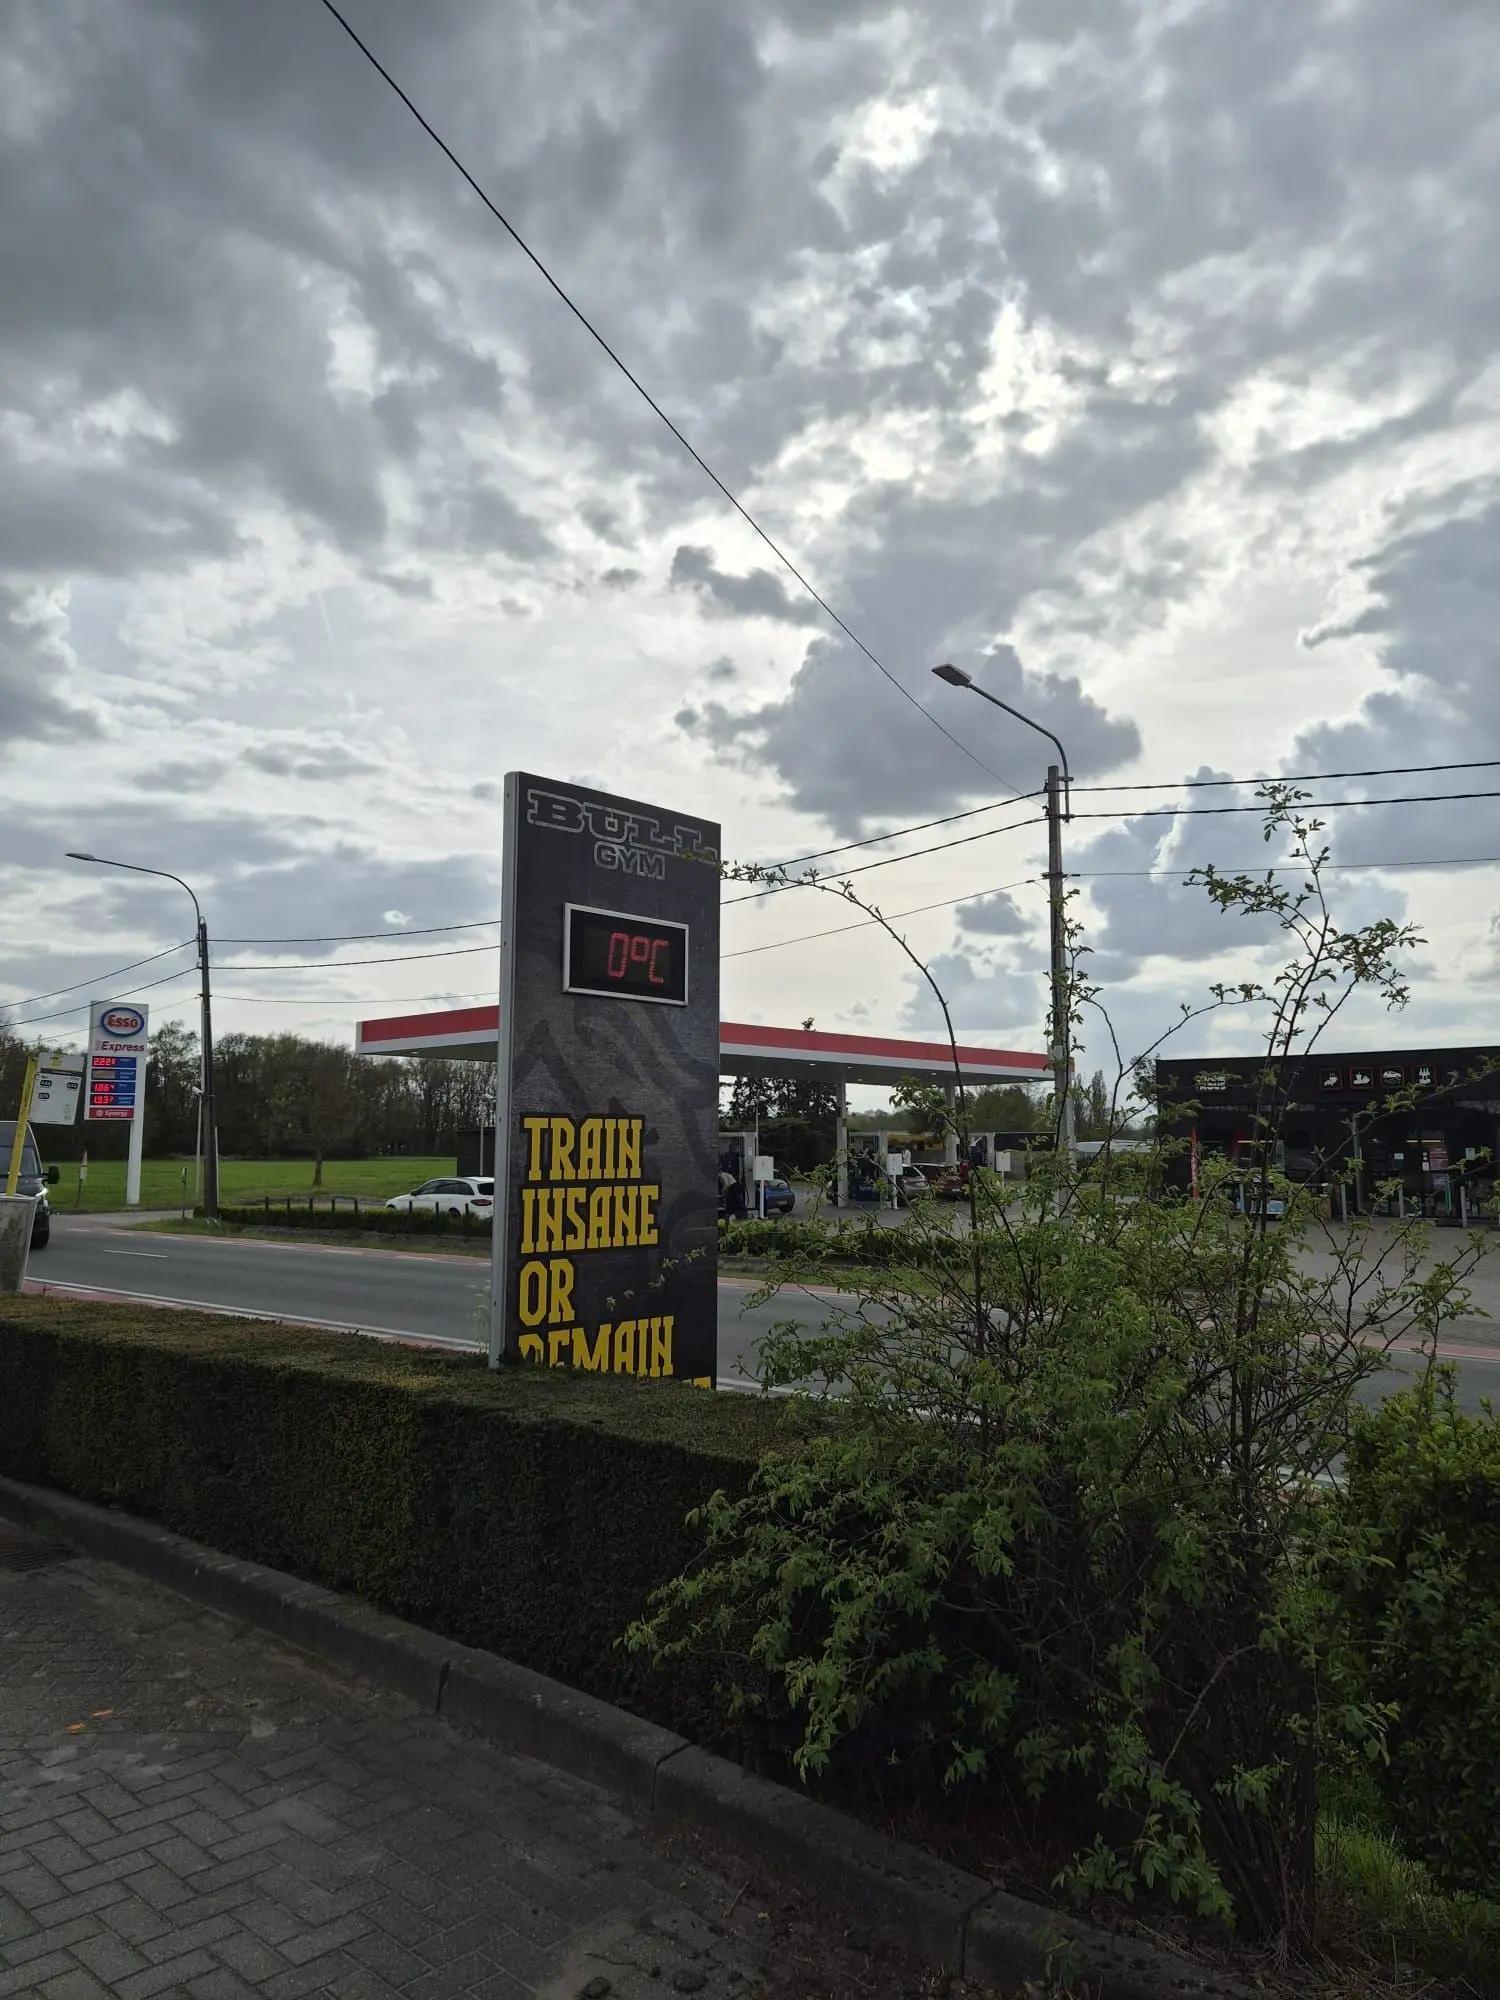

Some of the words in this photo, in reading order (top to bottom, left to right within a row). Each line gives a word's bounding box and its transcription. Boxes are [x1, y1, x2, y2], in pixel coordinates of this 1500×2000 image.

[527, 788, 718, 865] BULL
[594, 841, 666, 880] GYM
[101, 1040, 145, 1053] Express
[107, 1013, 138, 1028] Esso
[523, 1117, 643, 1181] TRAIN
[520, 1184, 661, 1254] INSANE
[518, 1258, 576, 1327] OR
